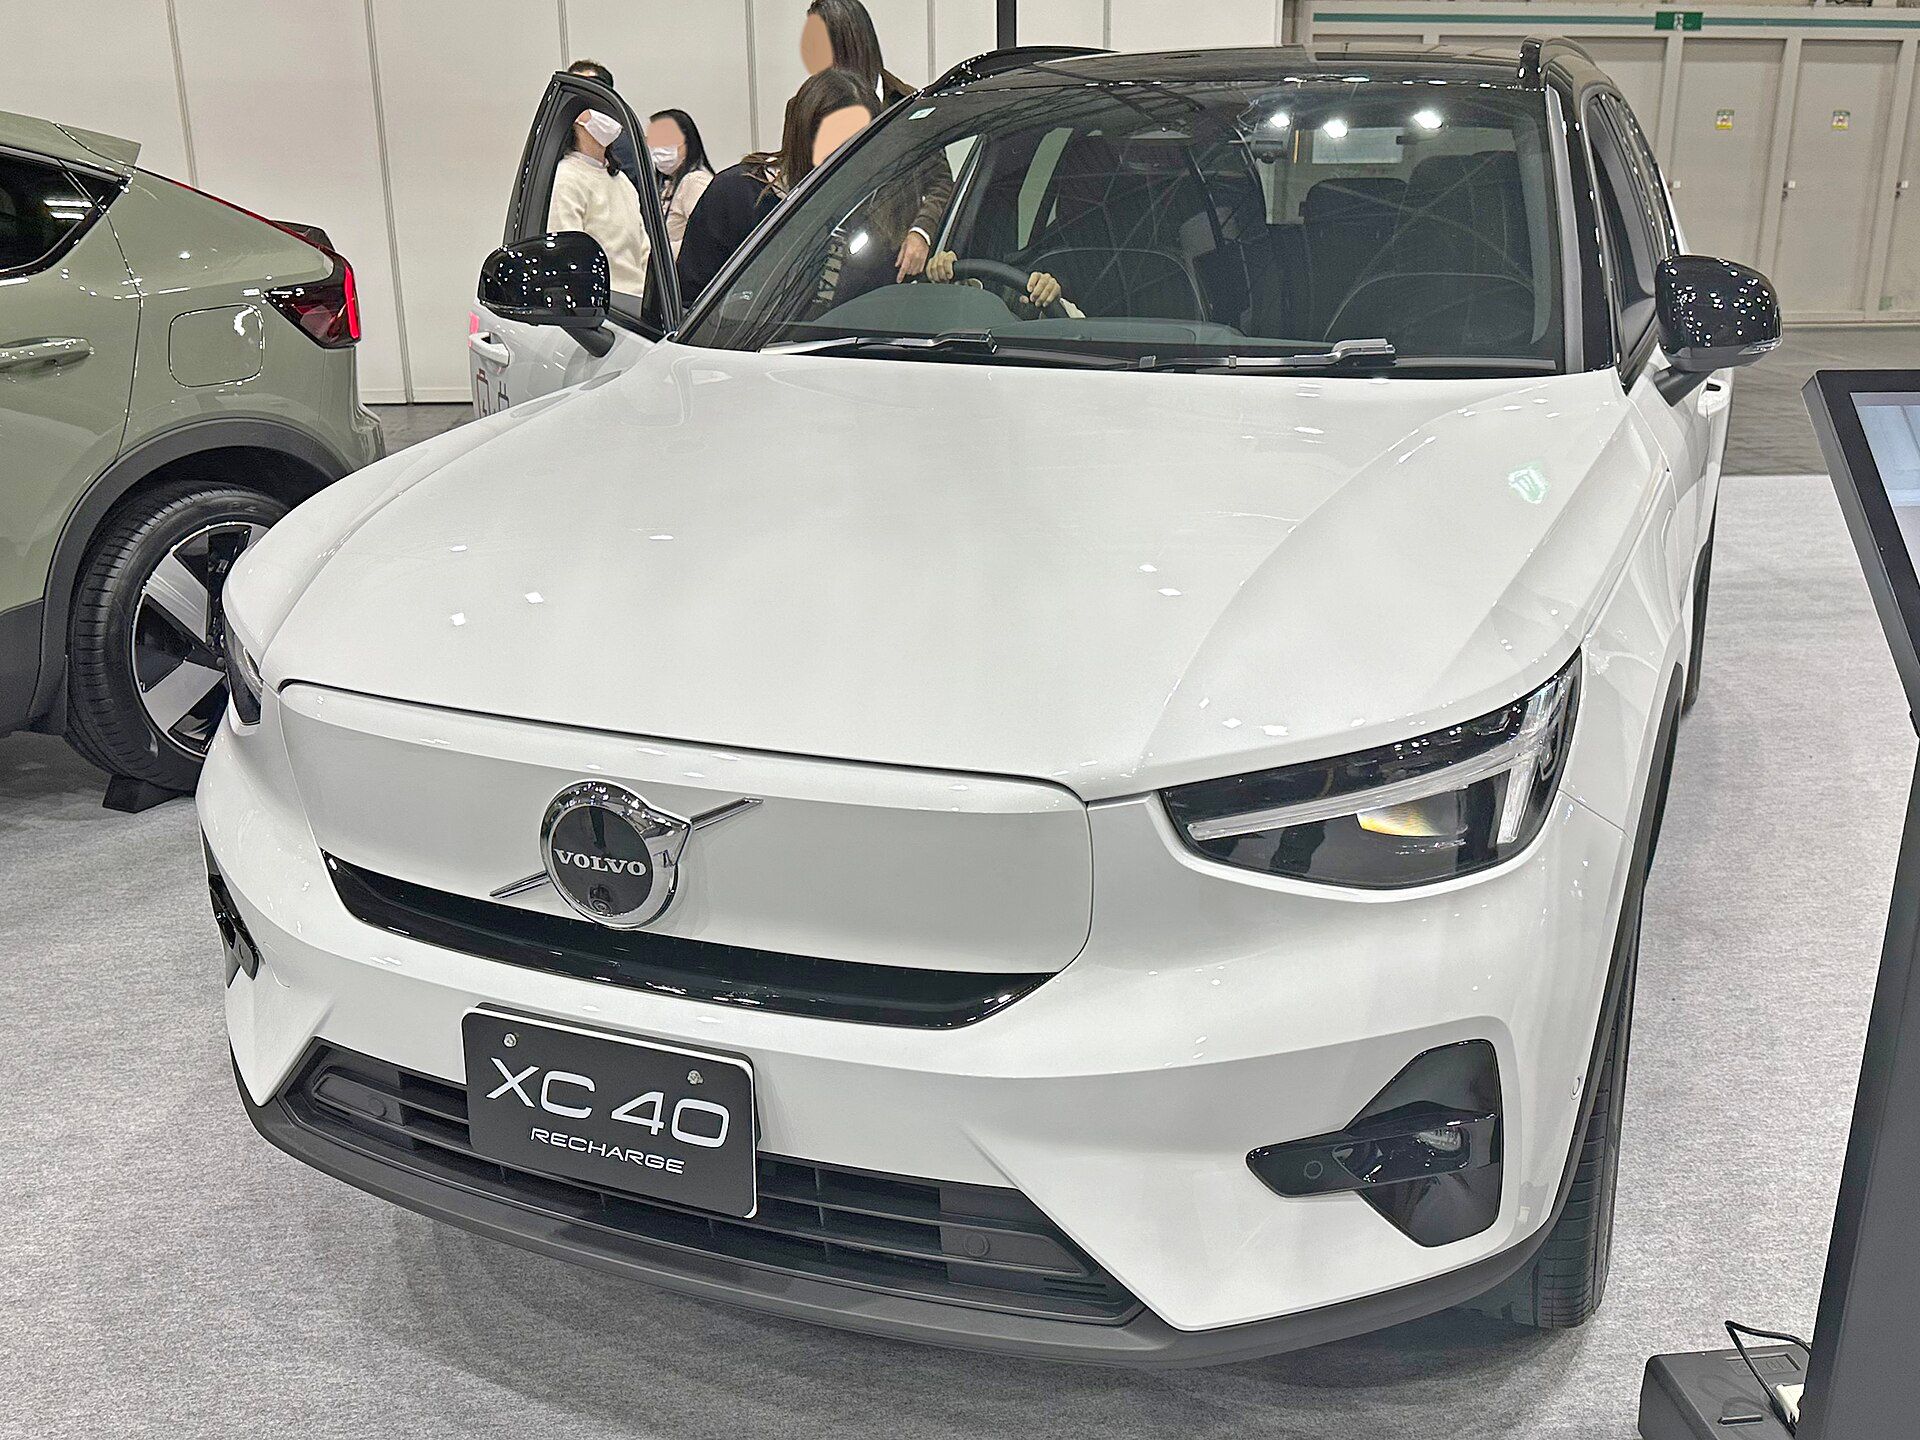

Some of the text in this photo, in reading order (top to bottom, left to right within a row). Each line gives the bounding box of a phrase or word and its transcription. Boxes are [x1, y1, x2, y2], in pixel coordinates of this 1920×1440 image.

[554, 849, 647, 876] VOLVO
[486, 1057, 730, 1148] XC 40
[531, 1128, 685, 1174] RECHARGE
